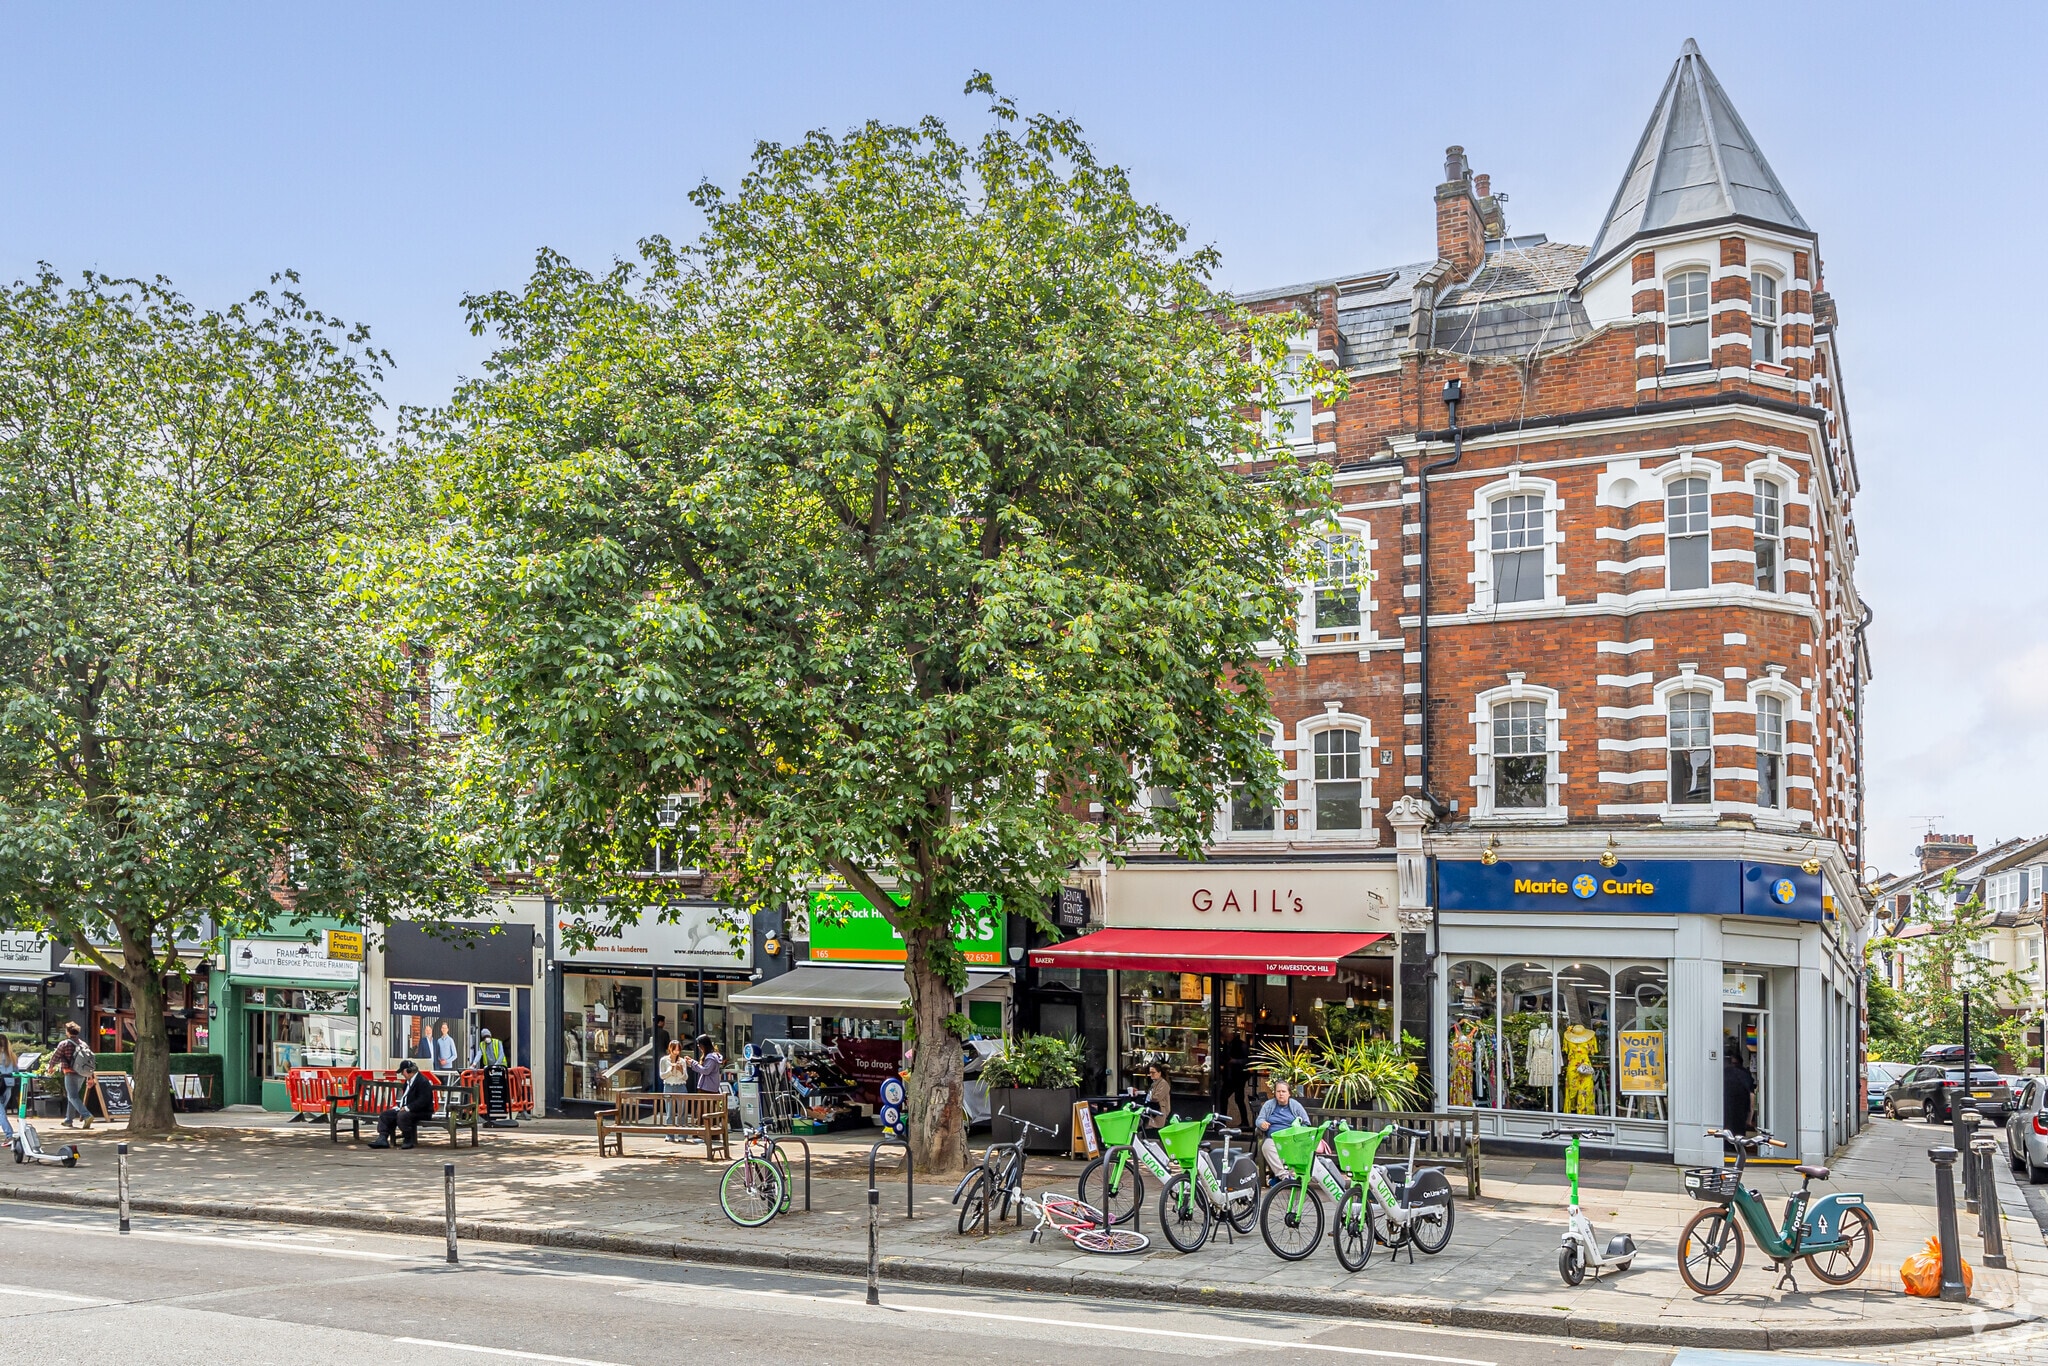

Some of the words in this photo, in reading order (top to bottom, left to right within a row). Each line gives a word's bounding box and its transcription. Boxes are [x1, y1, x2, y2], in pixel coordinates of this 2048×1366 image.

[1514, 878, 1569, 894] Marie
[1602, 878, 1654, 895] Curie
[1063, 889, 1082, 903] DENTAL
[1192, 888, 1304, 913] GAIL's
[1063, 902, 1083, 915] CENTRE
[333, 933, 357, 941] Picture
[333, 942, 358, 952] Framing
[816, 950, 829, 958] 165
[976, 954, 993, 962] 6521
[253, 958, 276, 966] QUALITY
[277, 958, 301, 967] BESPOKE
[303, 959, 327, 968] PICTURE
[328, 961, 354, 969] FRAMING
[393, 991, 407, 1001] The
[408, 992, 424, 1004] boys
[393, 1002, 410, 1011] back
[411, 1003, 419, 1011] in
[420, 1004, 440, 1013] town!
[1623, 1035, 1660, 1047] You'll
[855, 1058, 870, 1069] Top
[871, 1059, 893, 1070] drops
[1624, 1068, 1648, 1077] right
[1792, 1201, 1806, 1232] forest
